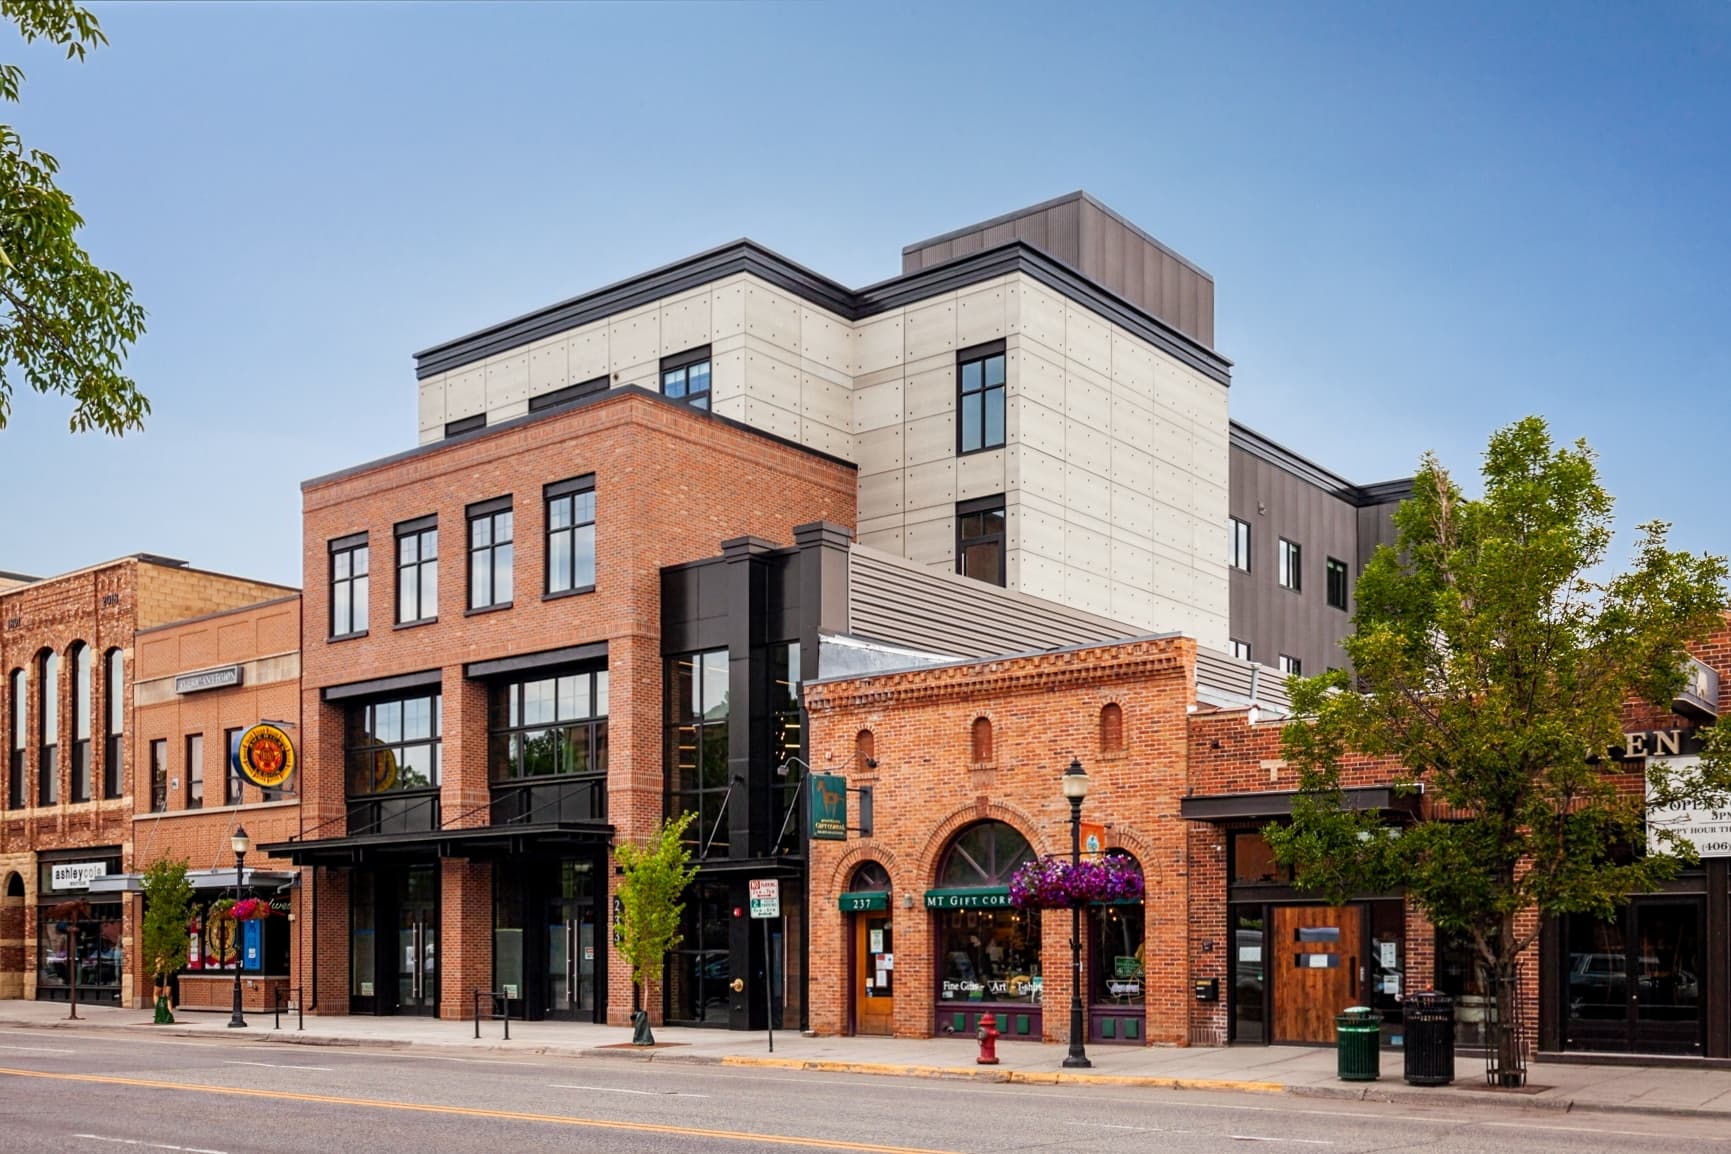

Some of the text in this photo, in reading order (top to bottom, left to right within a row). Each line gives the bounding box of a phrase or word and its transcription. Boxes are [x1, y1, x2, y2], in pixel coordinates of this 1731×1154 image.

[853, 899, 871, 909] 237
[927, 896, 944, 906] MT
[950, 896, 977, 906] GIFT
[943, 981, 959, 990] Fine
[992, 982, 1006, 991] Art
